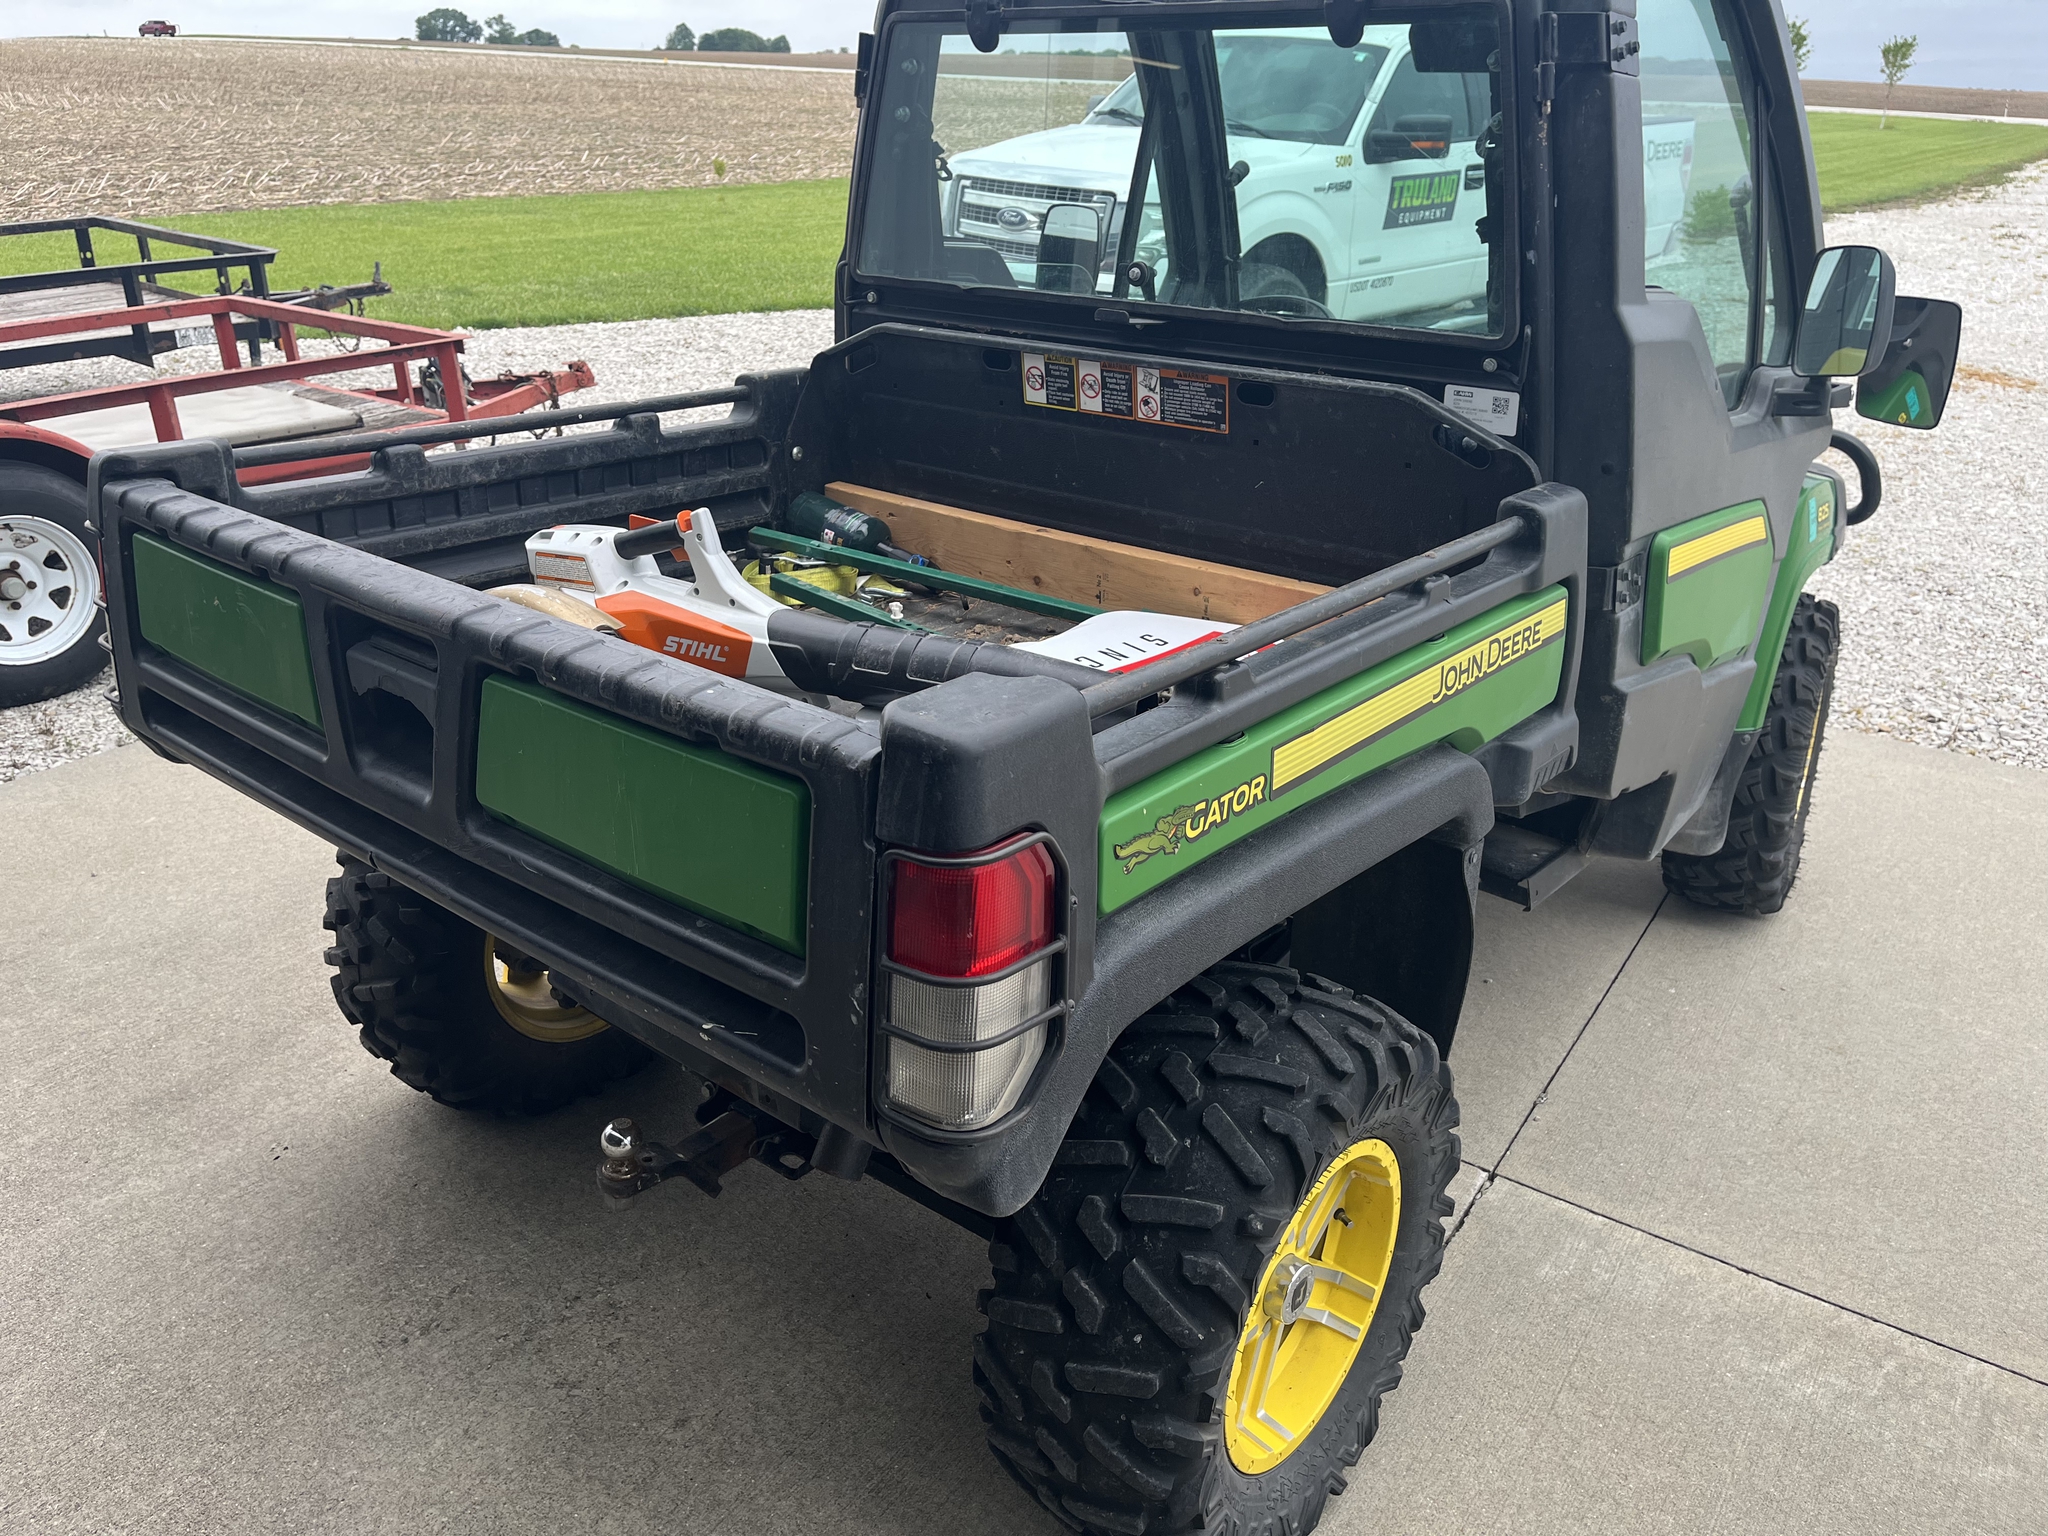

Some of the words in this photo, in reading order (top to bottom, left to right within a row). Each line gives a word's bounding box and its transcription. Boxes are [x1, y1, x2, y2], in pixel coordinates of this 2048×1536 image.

[1647, 140, 1683, 161] DEERE
[1391, 174, 1459, 209] TRULAND
[1001, 210, 1021, 224] Ford
[1398, 207, 1447, 224] EQUIPMENT
[1050, 354, 1073, 364] CAUTION
[1107, 361, 1132, 371] WARNING
[1183, 371, 1209, 382] WARNING
[663, 635, 726, 663] STIHL
[1433, 656, 1483, 702] JOHN
[1486, 619, 1543, 671] DEERE
[1185, 774, 1267, 841] GATOR
